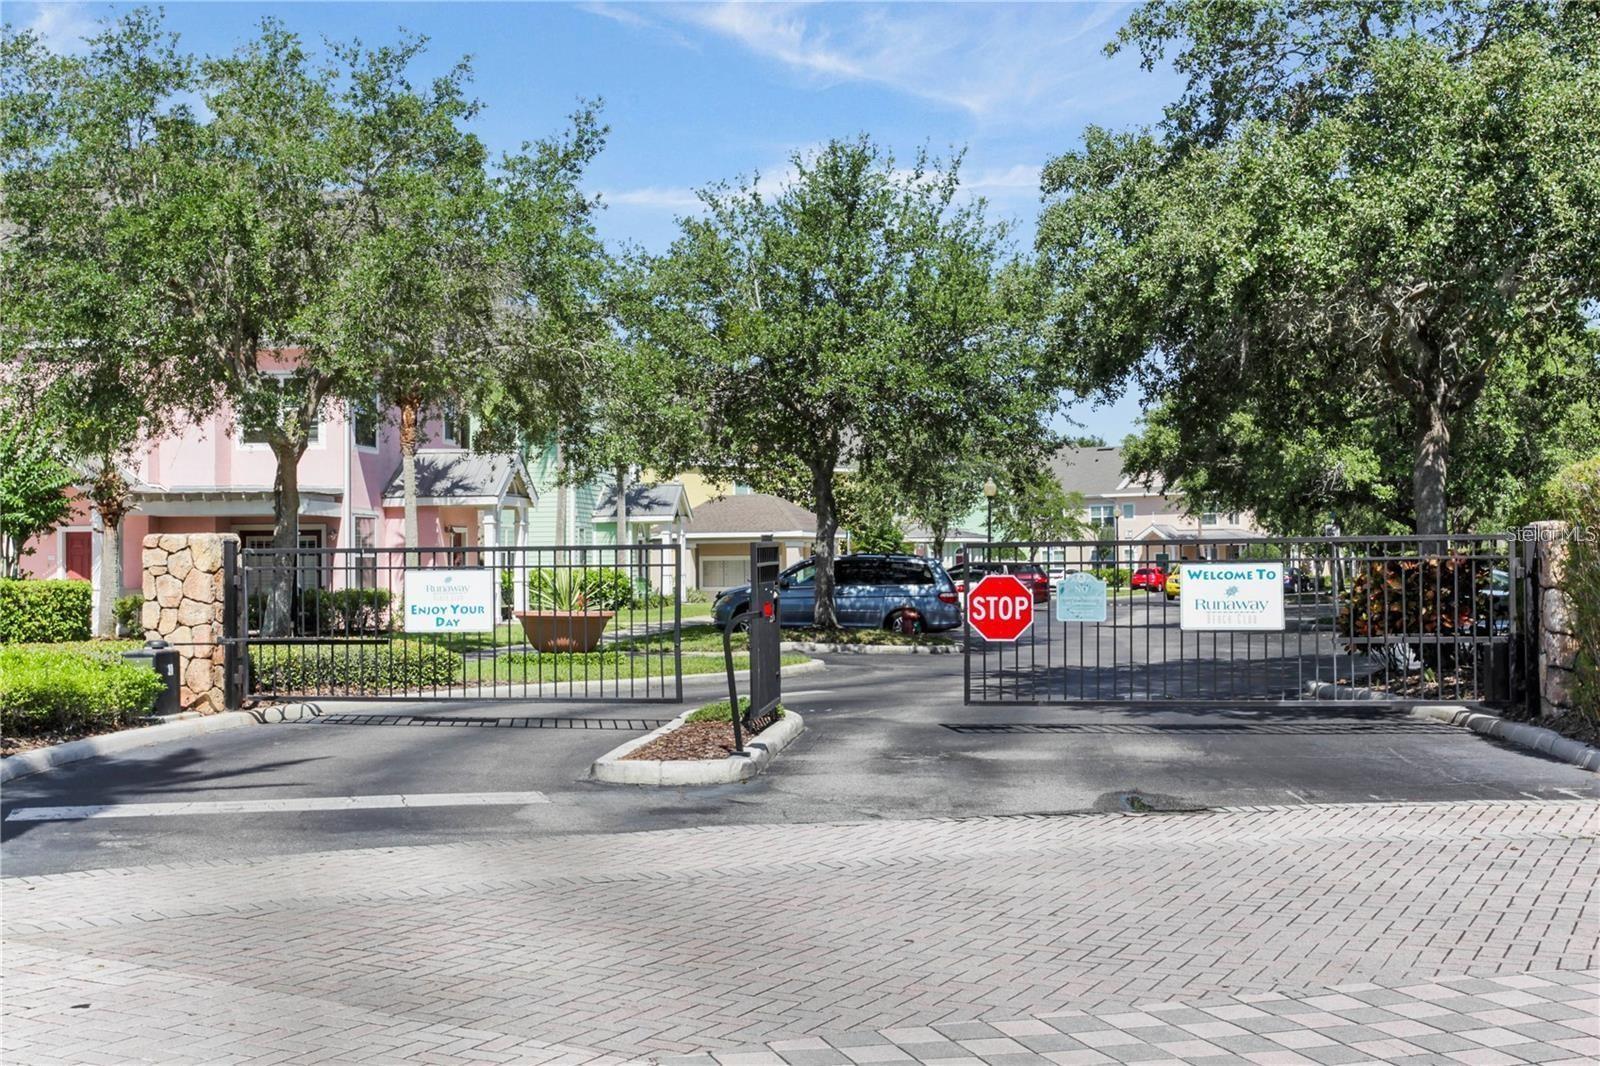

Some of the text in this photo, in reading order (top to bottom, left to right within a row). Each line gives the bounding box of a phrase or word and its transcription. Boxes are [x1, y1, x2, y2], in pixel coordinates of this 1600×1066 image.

[1187, 568, 1277, 580] WELCOME TO
[411, 604, 485, 615] ENJOY YOUR
[972, 596, 1029, 620] STOP
[1195, 598, 1269, 612] Runaway
[435, 617, 460, 628] DAY
